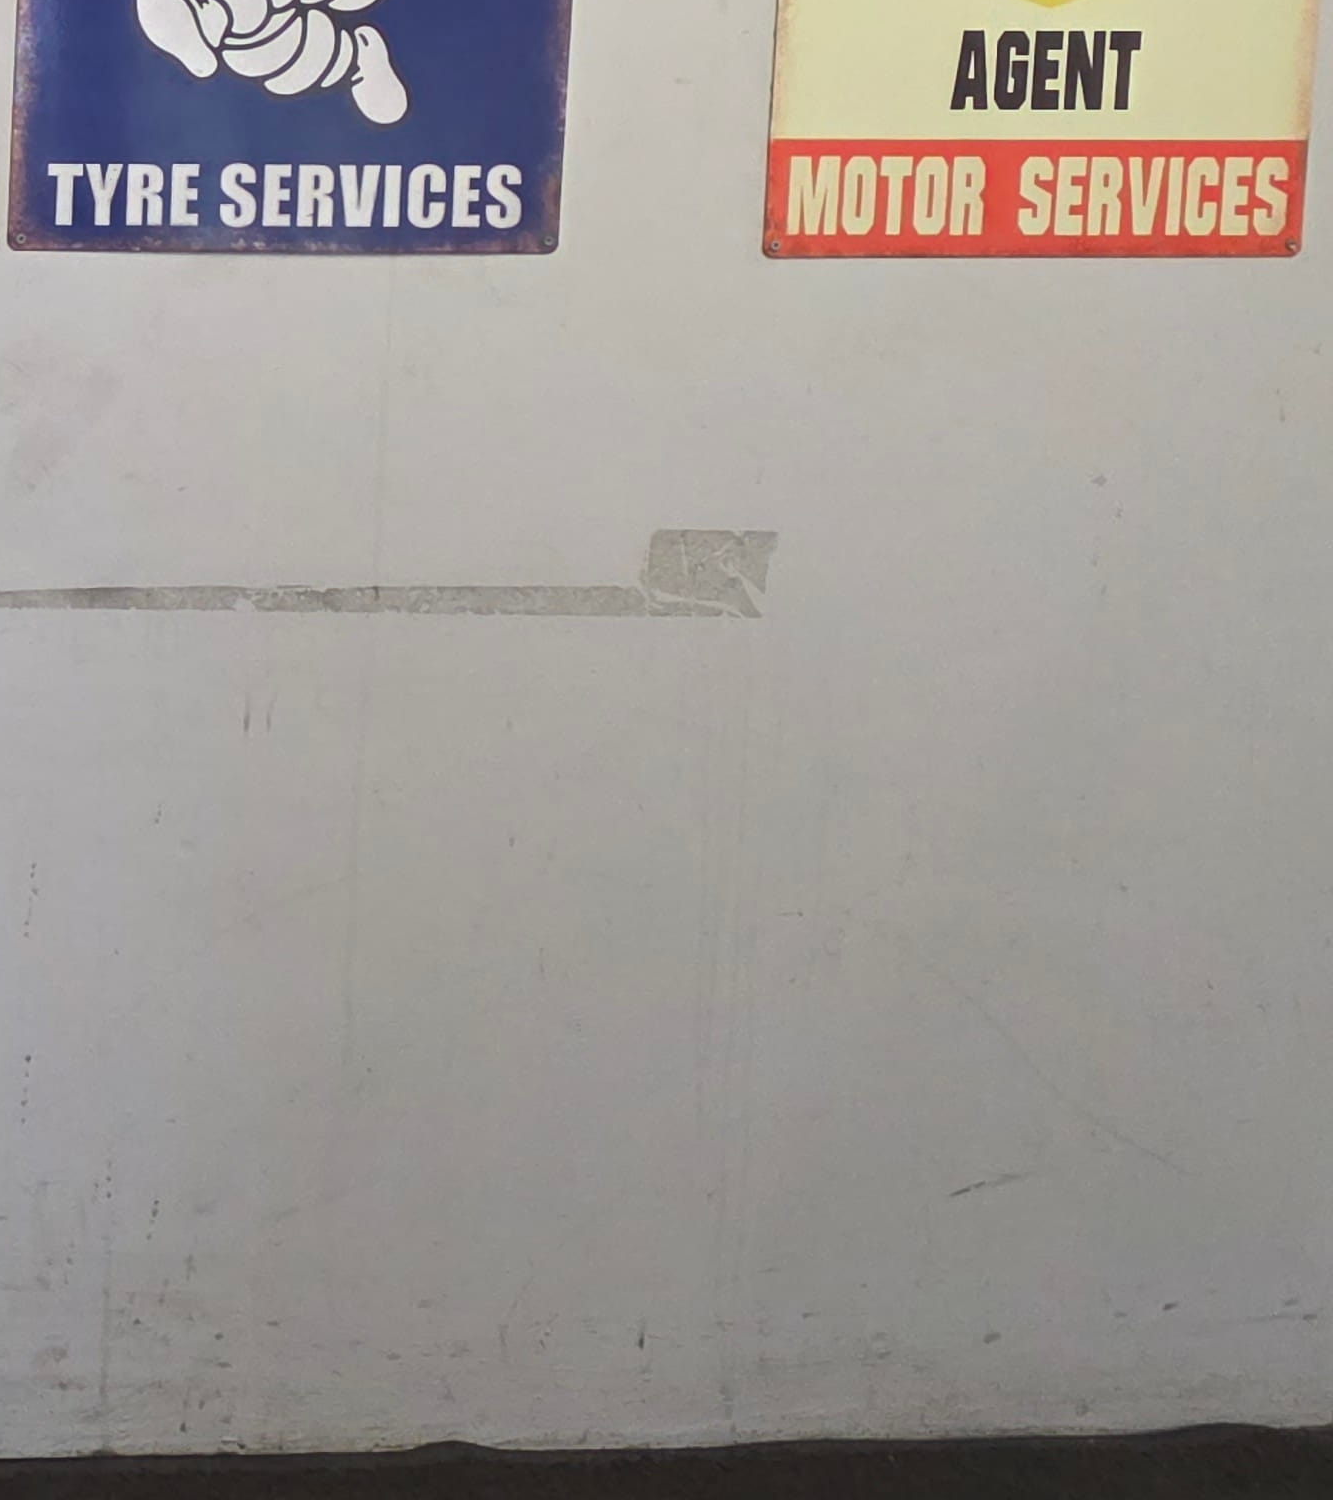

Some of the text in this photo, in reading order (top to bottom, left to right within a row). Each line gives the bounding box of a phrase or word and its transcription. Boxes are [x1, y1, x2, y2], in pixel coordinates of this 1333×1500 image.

[950, 29, 1142, 111] AGENT
[46, 162, 523, 229] TYRE SERVICES
[786, 155, 1290, 238] MOTOR SERVICES
